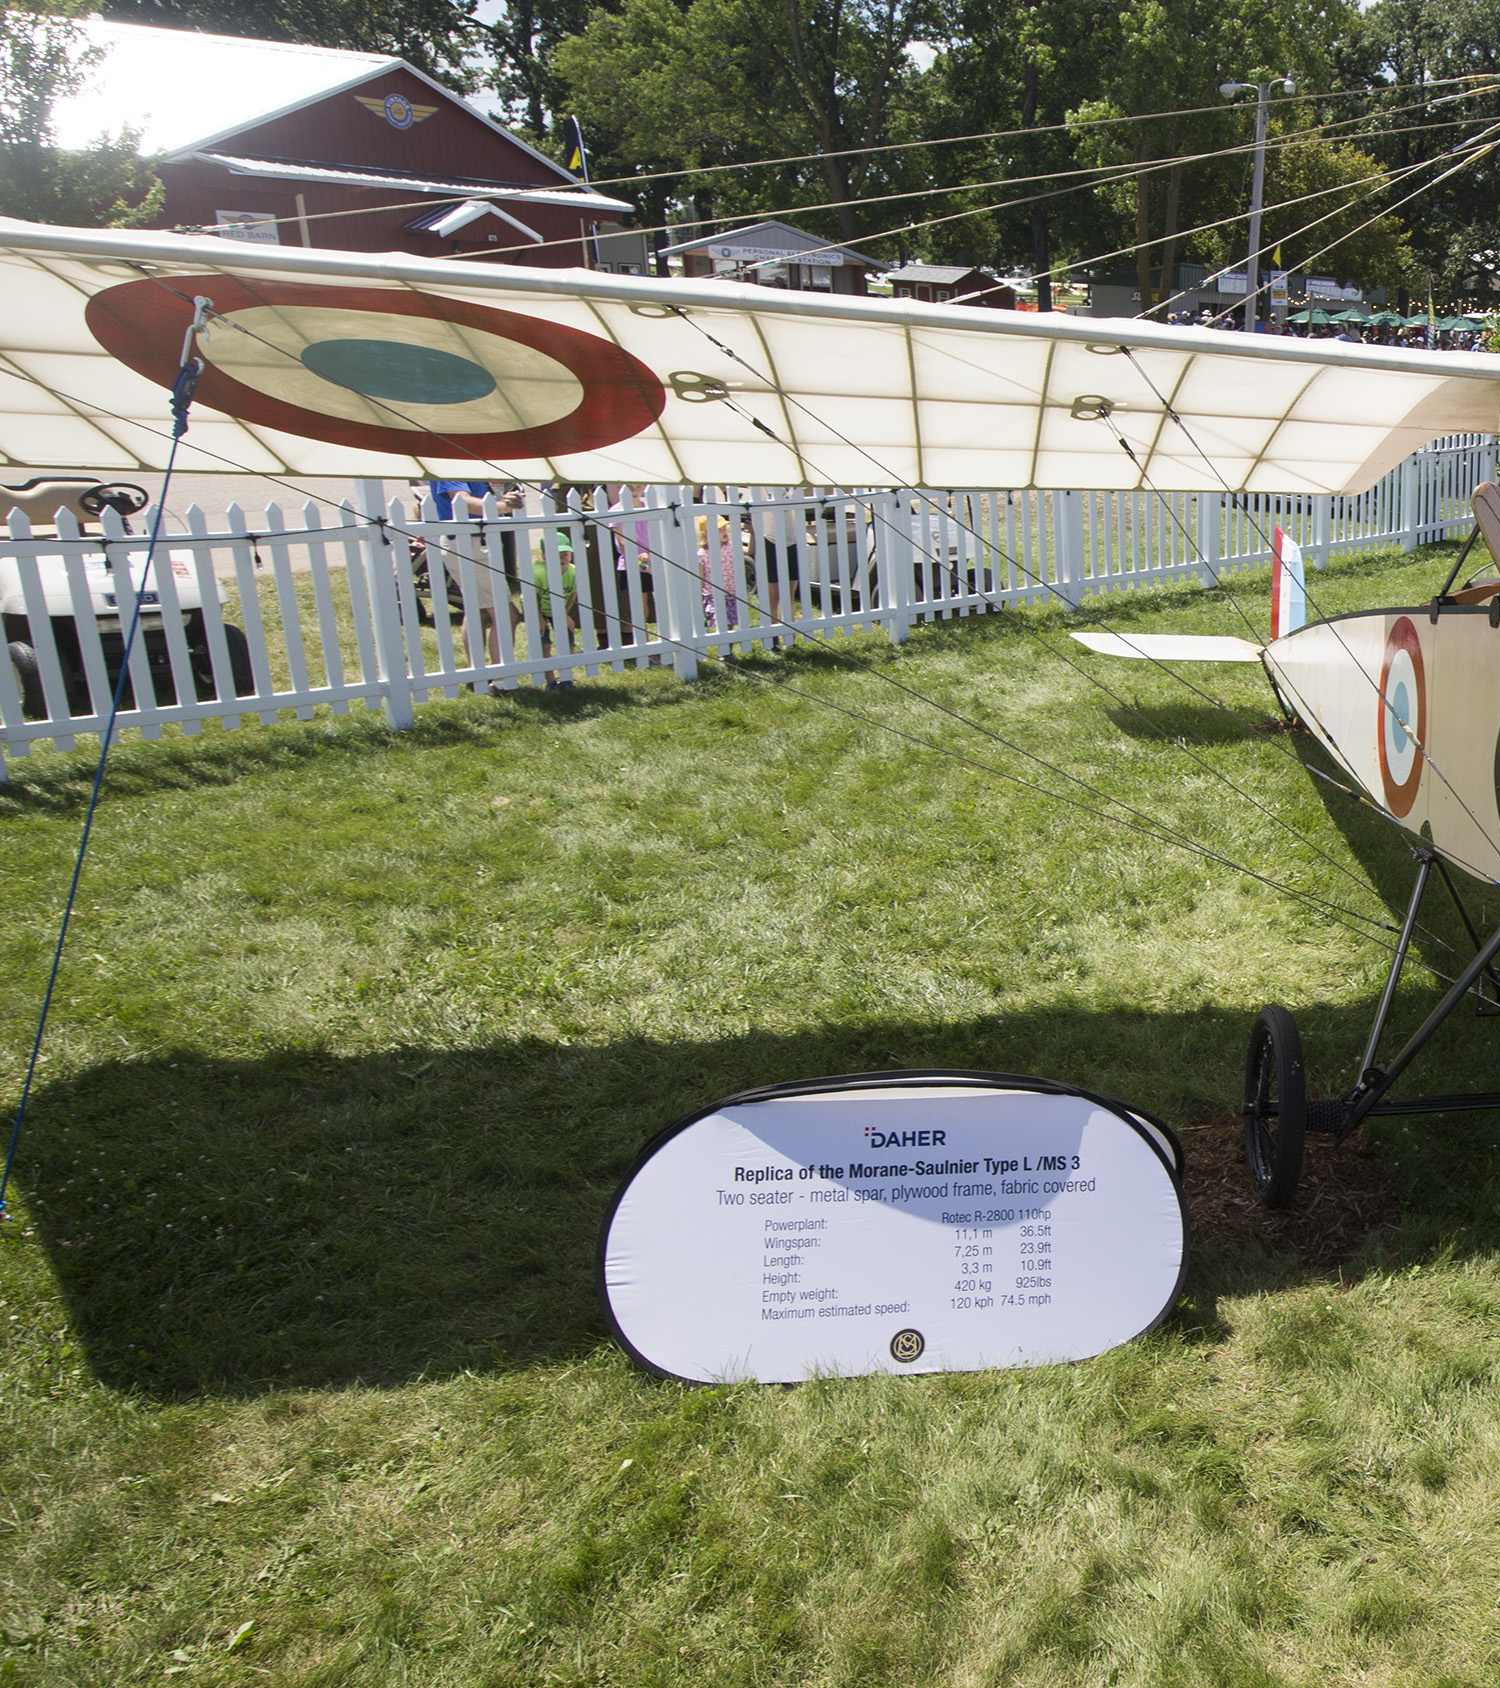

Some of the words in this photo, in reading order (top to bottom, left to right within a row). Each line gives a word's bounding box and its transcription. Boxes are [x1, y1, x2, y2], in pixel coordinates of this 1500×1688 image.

[222, 230, 244, 238] RED
[247, 232, 276, 240] BARN
[743, 248, 784, 257] PERSONAL
[799, 257, 831, 265] STATION
[870, 1130, 946, 1148] DAHER
[735, 1166, 793, 1184] Replica
[799, 1164, 815, 1180] of
[819, 1164, 844, 1179] the
[849, 1159, 979, 1179] Morane-Saulnier
[984, 1157, 1018, 1175] Type
[1023, 1157, 1032, 1171] L
[1036, 1156, 1067, 1171] /MS
[1071, 1156, 1081, 1170] 3
[716, 1190, 745, 1205] Two
[749, 1189, 794, 1205] seater
[810, 1187, 849, 1202] metal
[854, 1187, 887, 1204] spar,
[891, 1183, 948, 1203] plywood
[953, 1181, 997, 1197] frame,
[1001, 1179, 1039, 1195] fabric
[1043, 1177, 1096, 1193] covered
[765, 1218, 828, 1232] Powerplant:
[941, 1212, 972, 1223] Rotec
[974, 1209, 1015, 1222] R-2800
[1018, 1208, 1052, 1221] 110hp
[764, 1236, 821, 1251] Wingspan:
[955, 1228, 978, 1241] 11,1
[982, 1229, 993, 1239] m
[1020, 1225, 1052, 1237] 36.5ft
[763, 1254, 804, 1268] Length:
[955, 1245, 979, 1258] 7,25
[982, 1246, 993, 1256] m
[1020, 1242, 1052, 1254] 23.9ft
[762, 1272, 801, 1286] Height:
[961, 1262, 979, 1275] 3,3
[982, 1263, 993, 1273] m
[1021, 1259, 1052, 1271] 10.9ft
[762, 1290, 796, 1304] Empty
[800, 1288, 839, 1302] weight:
[954, 1279, 976, 1291] 420
[979, 1279, 992, 1292] kg
[1015, 1276, 1052, 1288] 925lbs
[761, 1307, 815, 1320] Maximum
[818, 1303, 871, 1318] estimated
[874, 1301, 910, 1316] speed:
[950, 1297, 971, 1309] 120
[974, 1296, 994, 1310] kph
[1001, 1294, 1025, 1306] 74.5
[1028, 1293, 1051, 1306] mph
